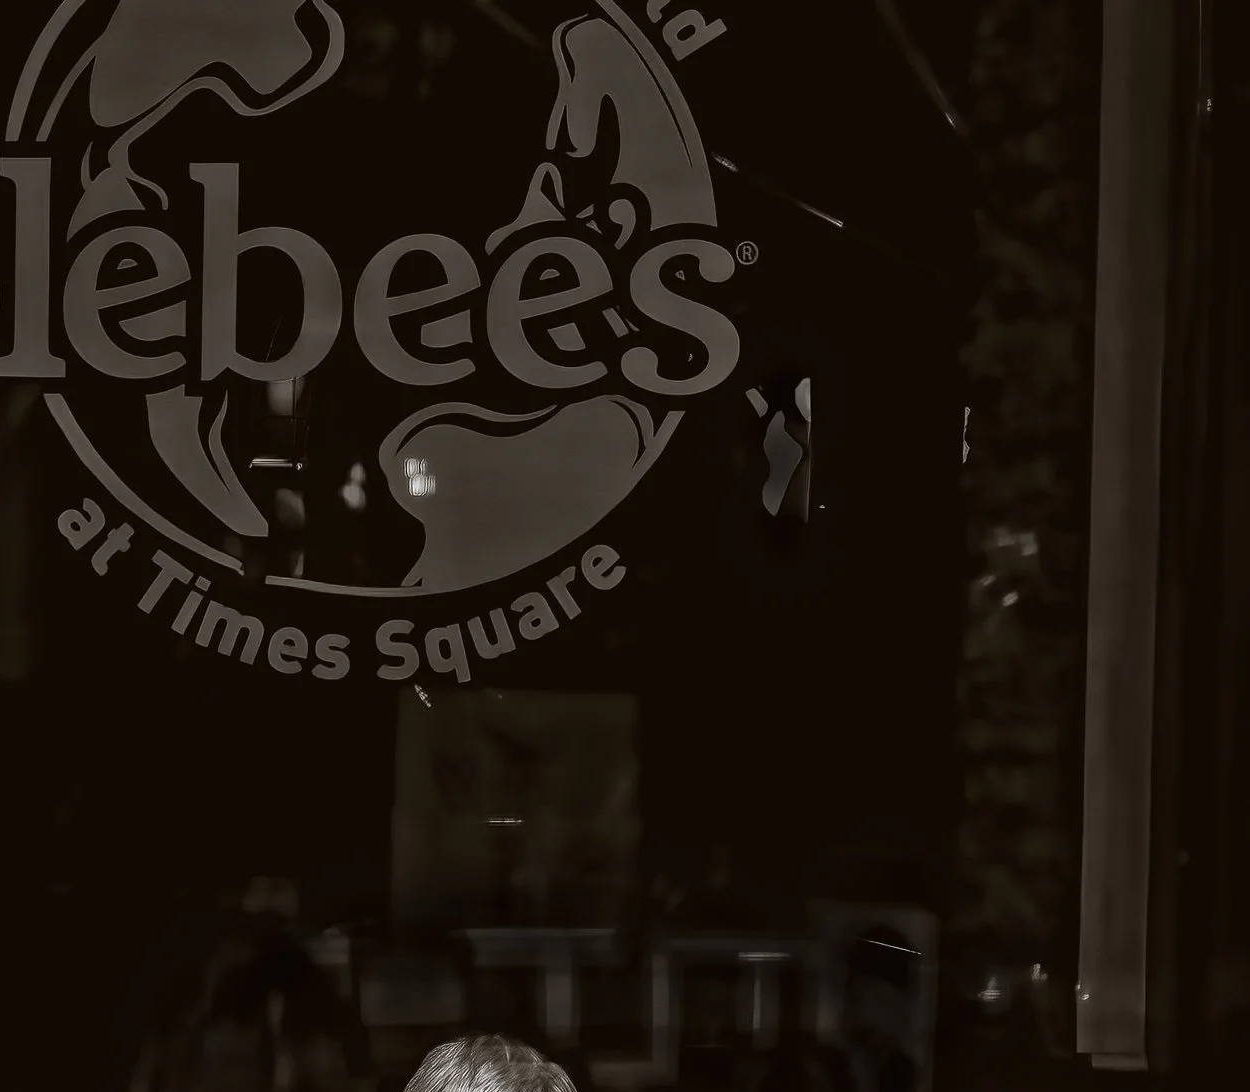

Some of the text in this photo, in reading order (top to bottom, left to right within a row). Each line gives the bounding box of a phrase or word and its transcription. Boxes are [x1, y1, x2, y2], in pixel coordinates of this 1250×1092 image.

[57, 497, 627, 684] at Times Square
